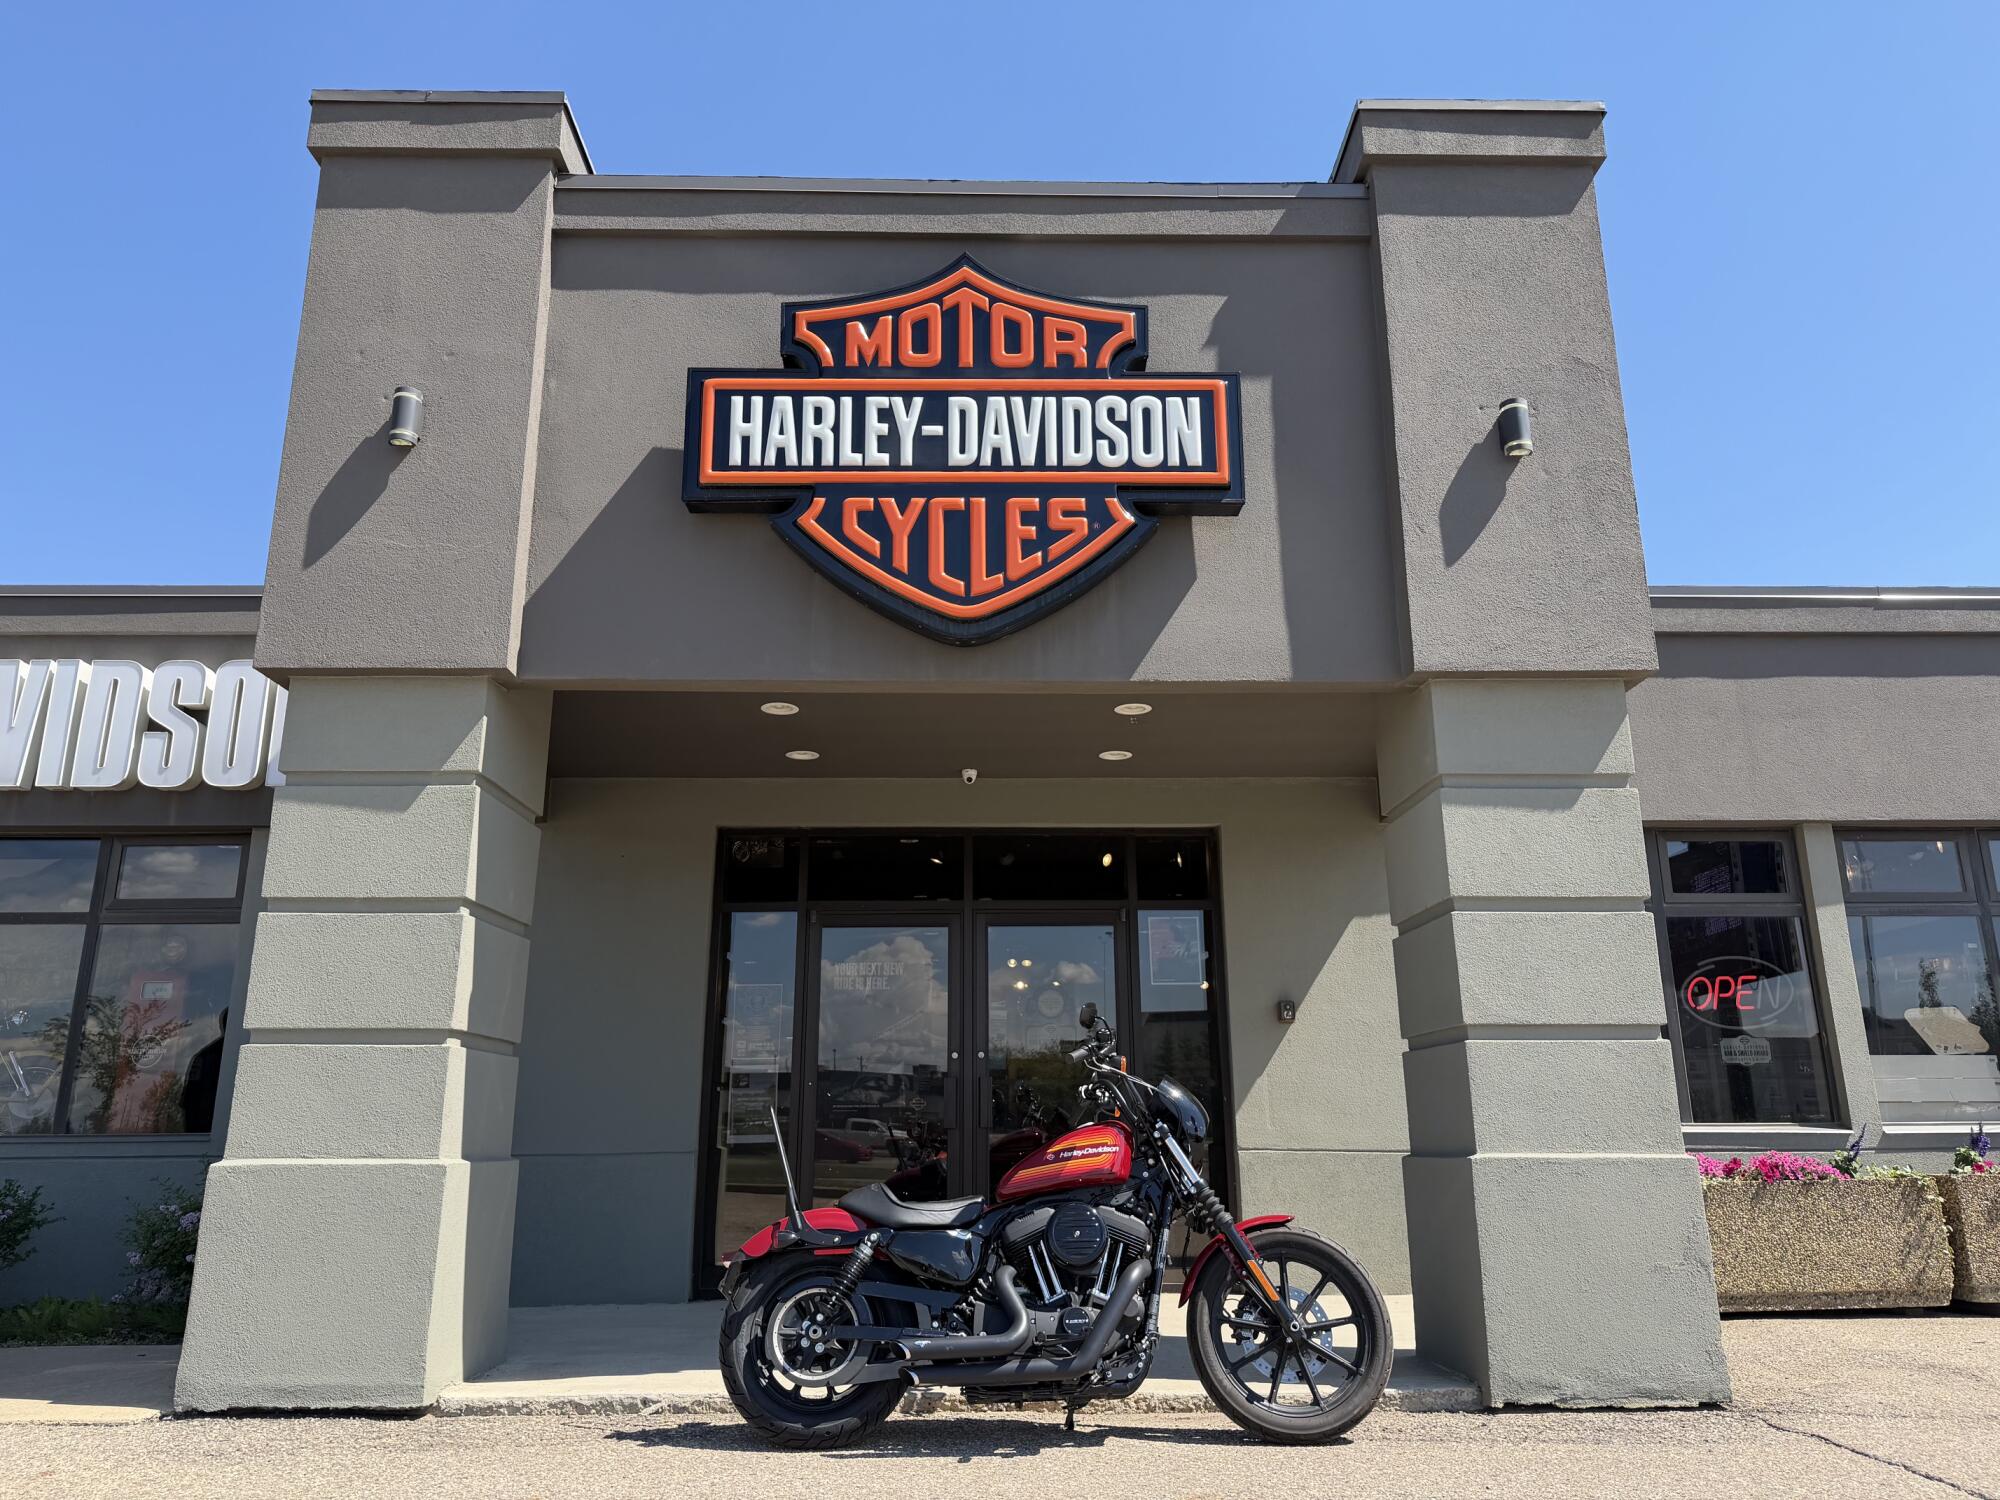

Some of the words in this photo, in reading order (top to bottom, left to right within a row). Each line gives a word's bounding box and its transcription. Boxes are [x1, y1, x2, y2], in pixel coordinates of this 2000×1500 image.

[846, 287, 1088, 368] MOTOR
[728, 395, 1203, 468] HARLEY-DAVIDSON
[842, 497, 1089, 597] CYCLES
[0, 659, 289, 790] VIDSO
[859, 962, 882, 976] NEXT
[1687, 975, 1781, 1011] OPEN
[1060, 1146, 1119, 1158] Harley-Davidson
